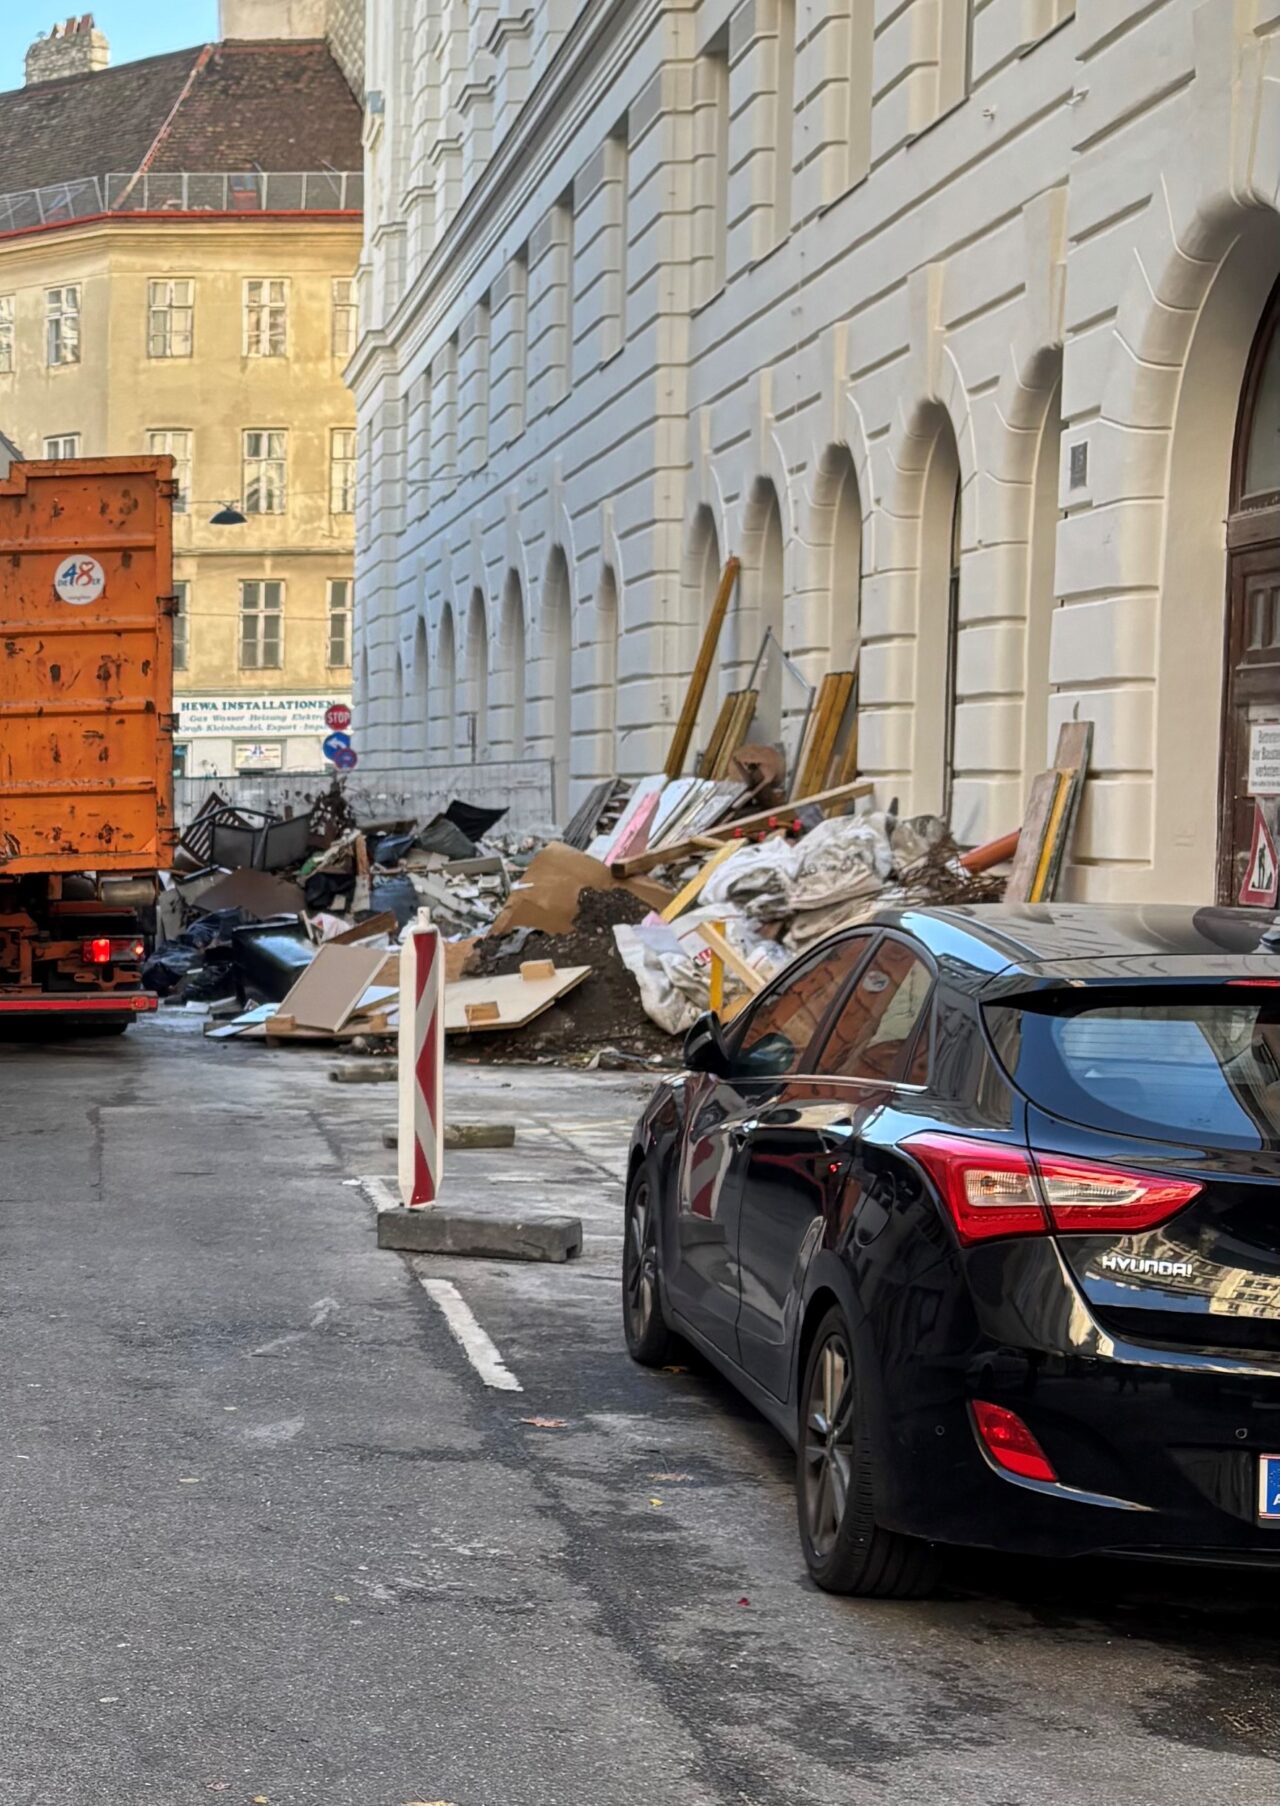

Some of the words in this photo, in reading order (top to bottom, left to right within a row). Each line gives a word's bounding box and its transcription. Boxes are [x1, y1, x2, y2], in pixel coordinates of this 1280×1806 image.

[181, 702, 218, 711] HEWA
[222, 700, 335, 710] INSTALLATIONEN
[326, 711, 350, 723] STOP
[1102, 1256, 1192, 1278] HYUNDAI
